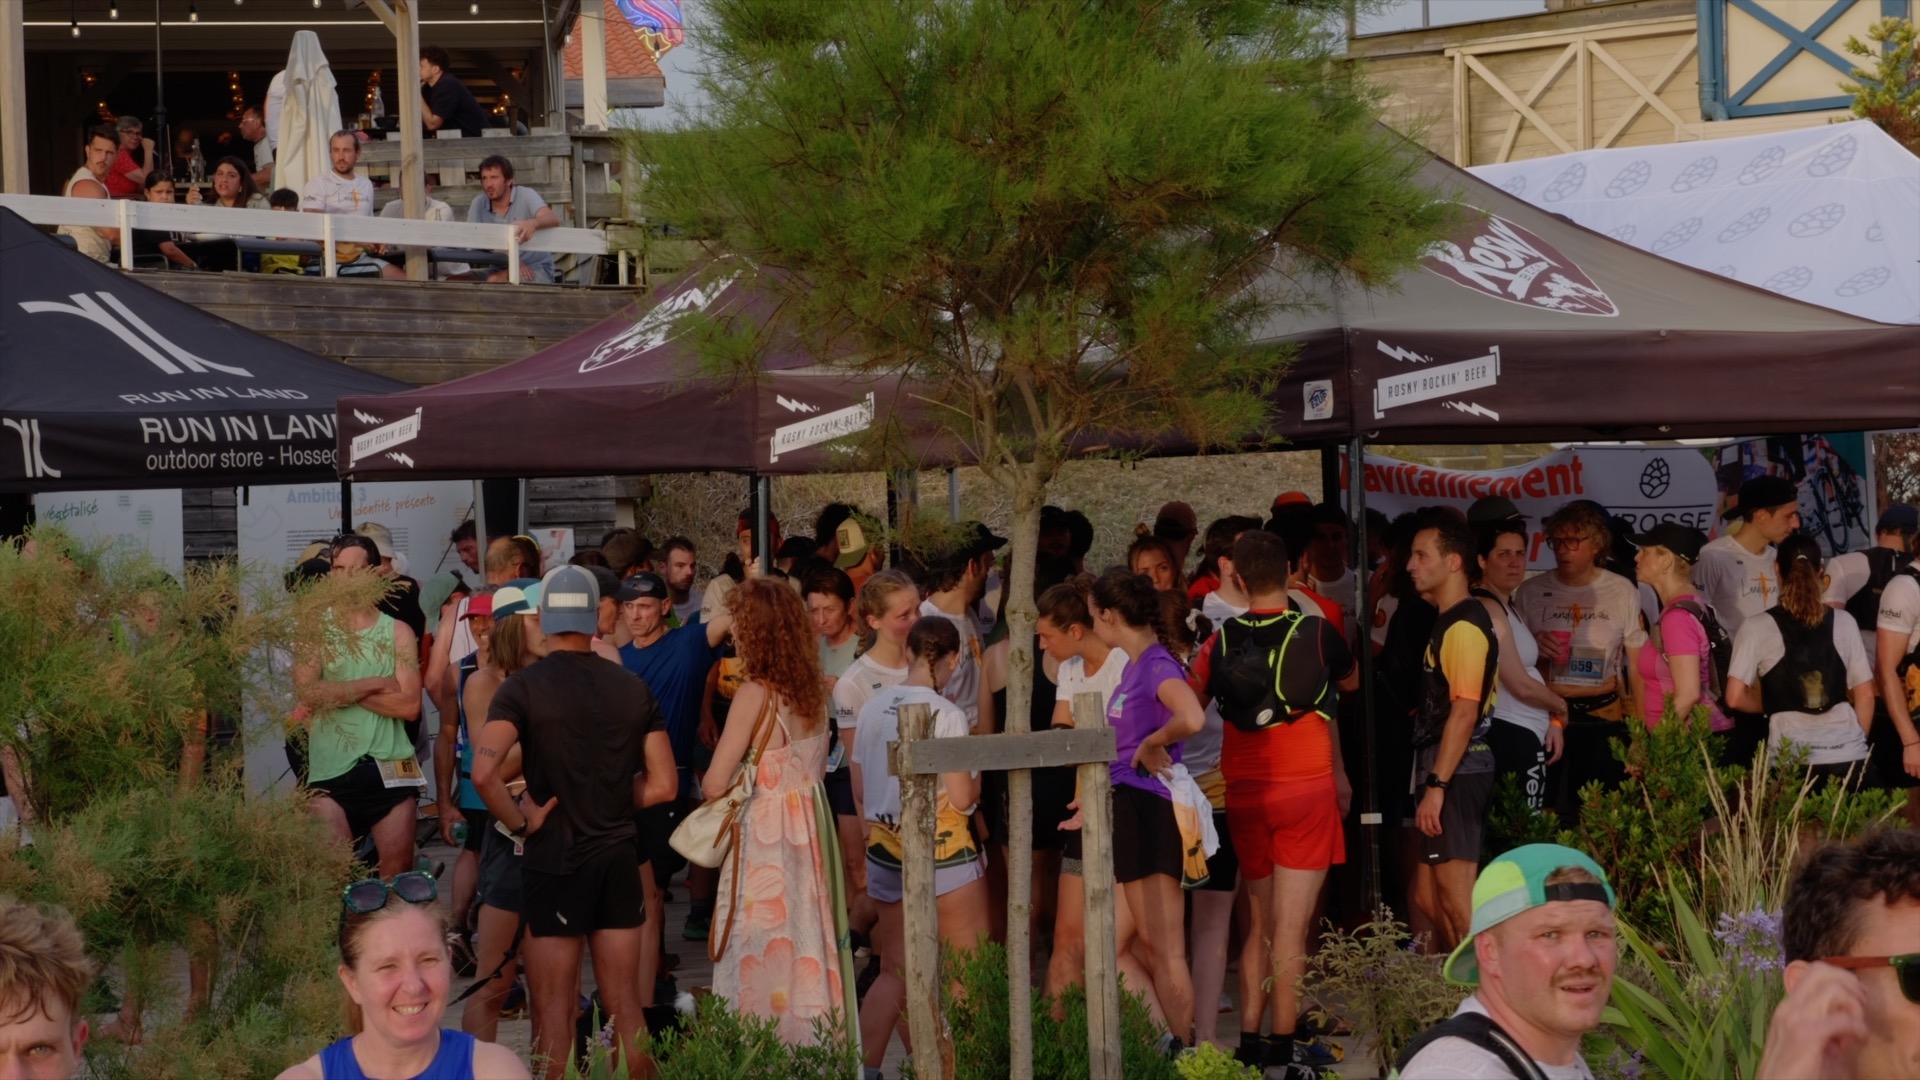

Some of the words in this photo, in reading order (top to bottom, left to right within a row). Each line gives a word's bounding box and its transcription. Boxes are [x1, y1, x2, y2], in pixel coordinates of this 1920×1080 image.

[1388, 380, 1418, 398] ROSNY
[1422, 372, 1460, 391] ROCKIN'
[1465, 366, 1487, 382] BEER
[118, 390, 186, 405] RUN
[187, 387, 229, 400] IN
[226, 386, 309, 400] LAND
[139, 416, 217, 444] RUN
[220, 416, 258, 442] IN
[263, 413, 338, 440] LAN
[398, 423, 413, 437] BEER
[146, 448, 215, 470] outdoor
[220, 448, 264, 468] store
[358, 487, 366, 503] 3
[395, 494, 437, 517] présente
[1570, 660, 1593, 673] 659
[401, 761, 413, 773] 817
